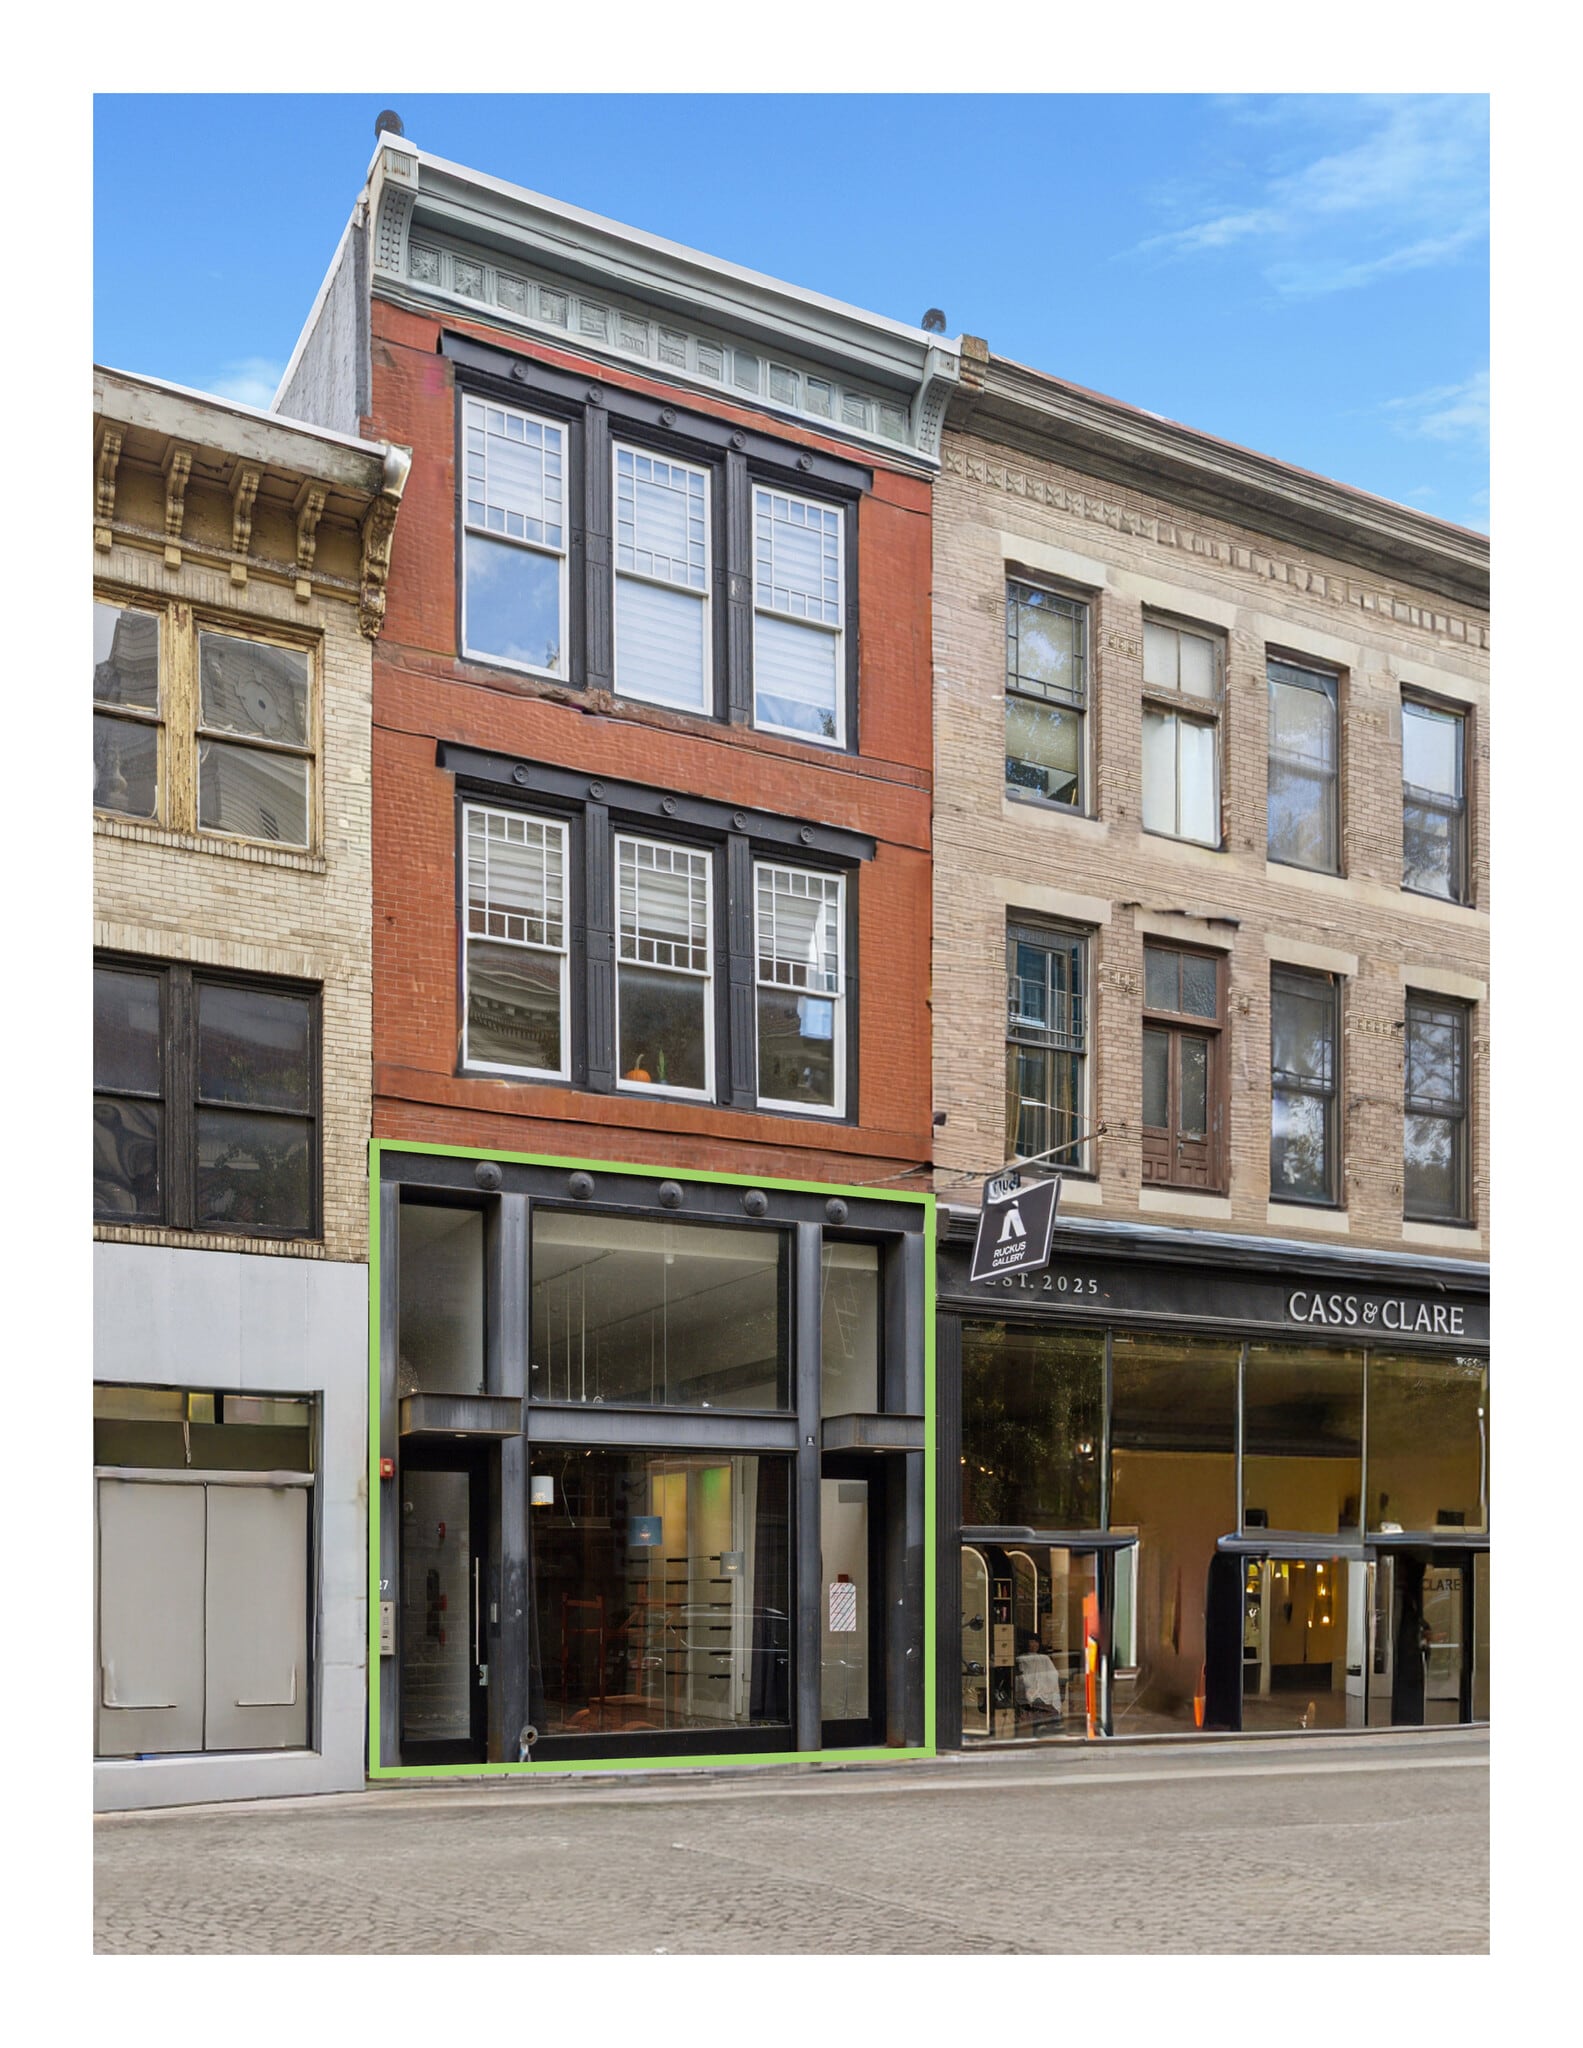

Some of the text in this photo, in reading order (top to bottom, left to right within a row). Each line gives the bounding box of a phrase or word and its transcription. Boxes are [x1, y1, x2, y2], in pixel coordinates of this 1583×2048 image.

[993, 1241, 1026, 1258] RUCKUS
[992, 1251, 1025, 1267] GALLERY
[1042, 1275, 1098, 1294] 2025
[1289, 1291, 1465, 1335] CASS & CLARE
